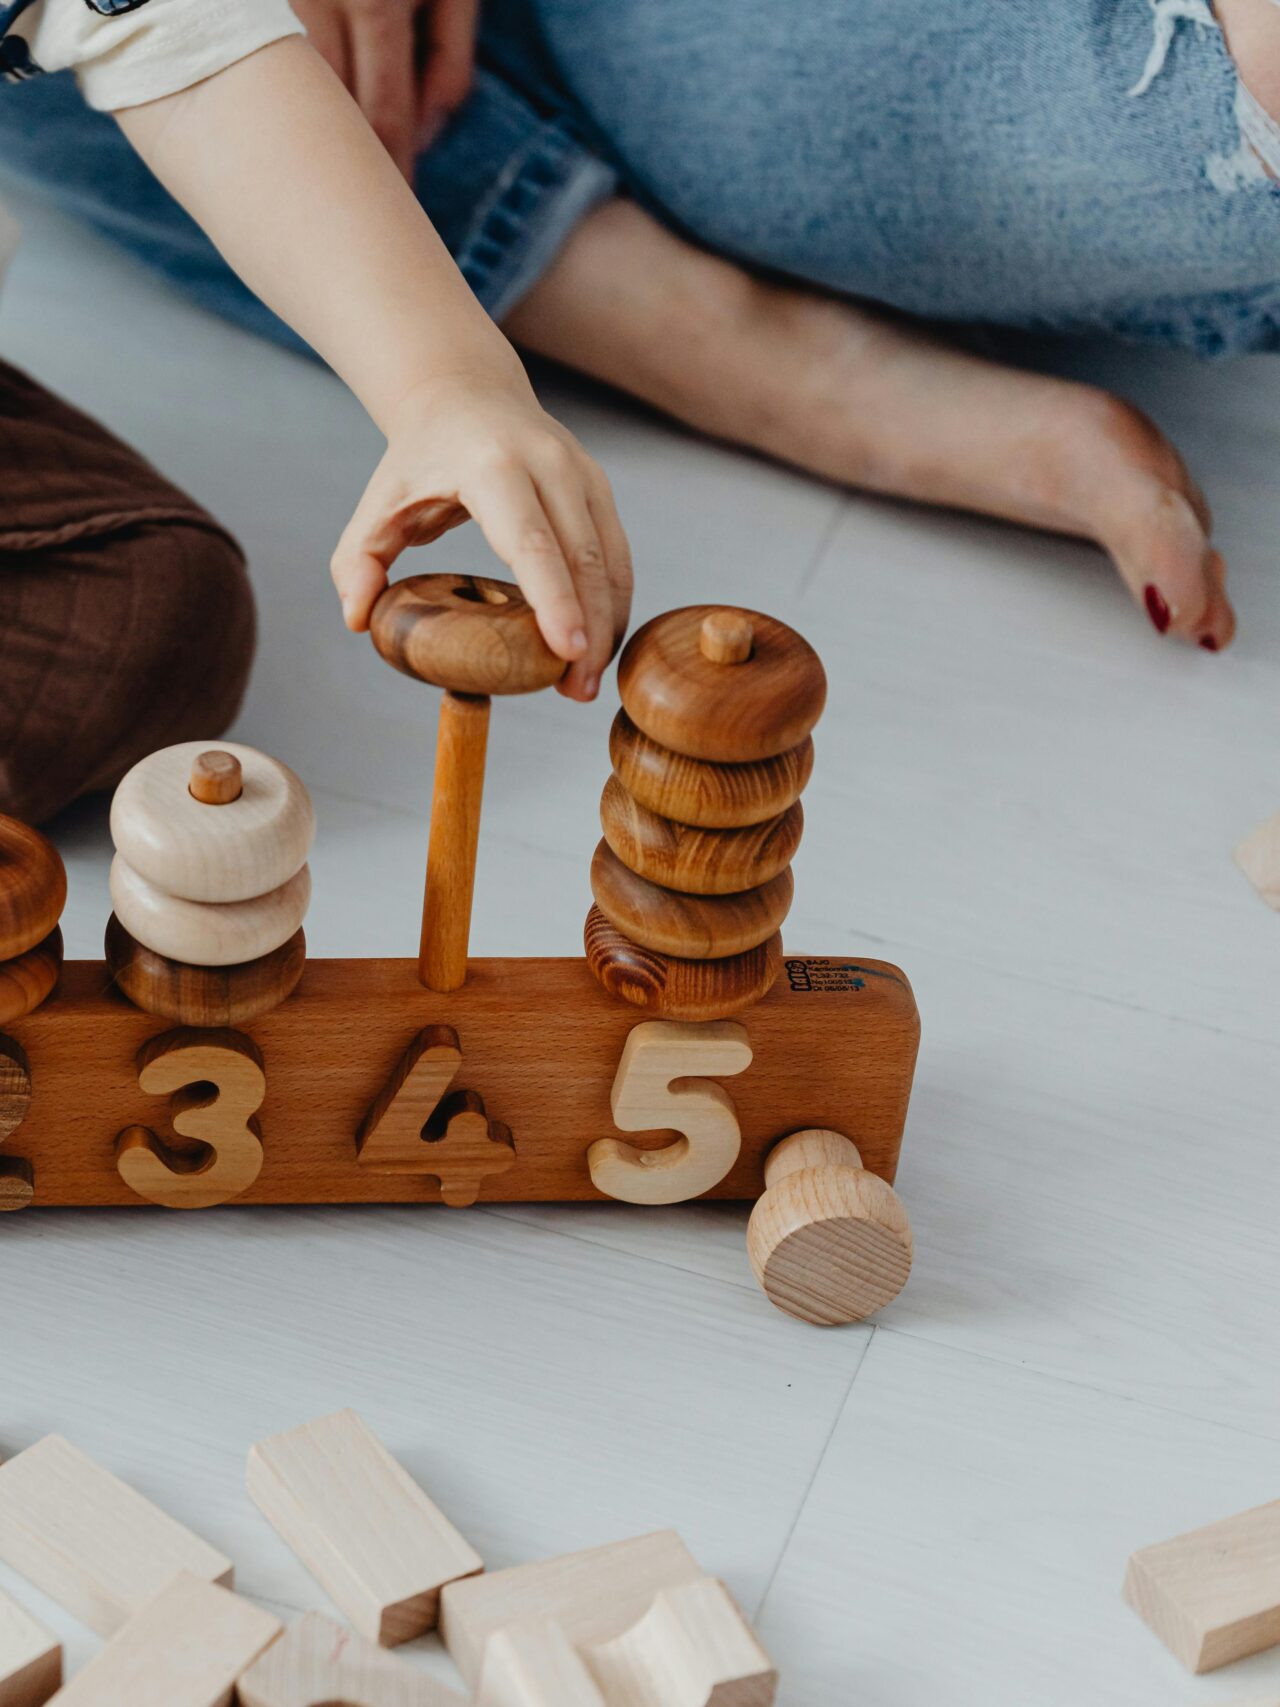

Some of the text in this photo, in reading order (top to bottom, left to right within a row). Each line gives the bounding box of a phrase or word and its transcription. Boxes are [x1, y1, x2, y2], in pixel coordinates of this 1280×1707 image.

[116, 1025, 267, 1208] 3
[355, 1023, 517, 1208] 4
[586, 1021, 754, 1206] 5
